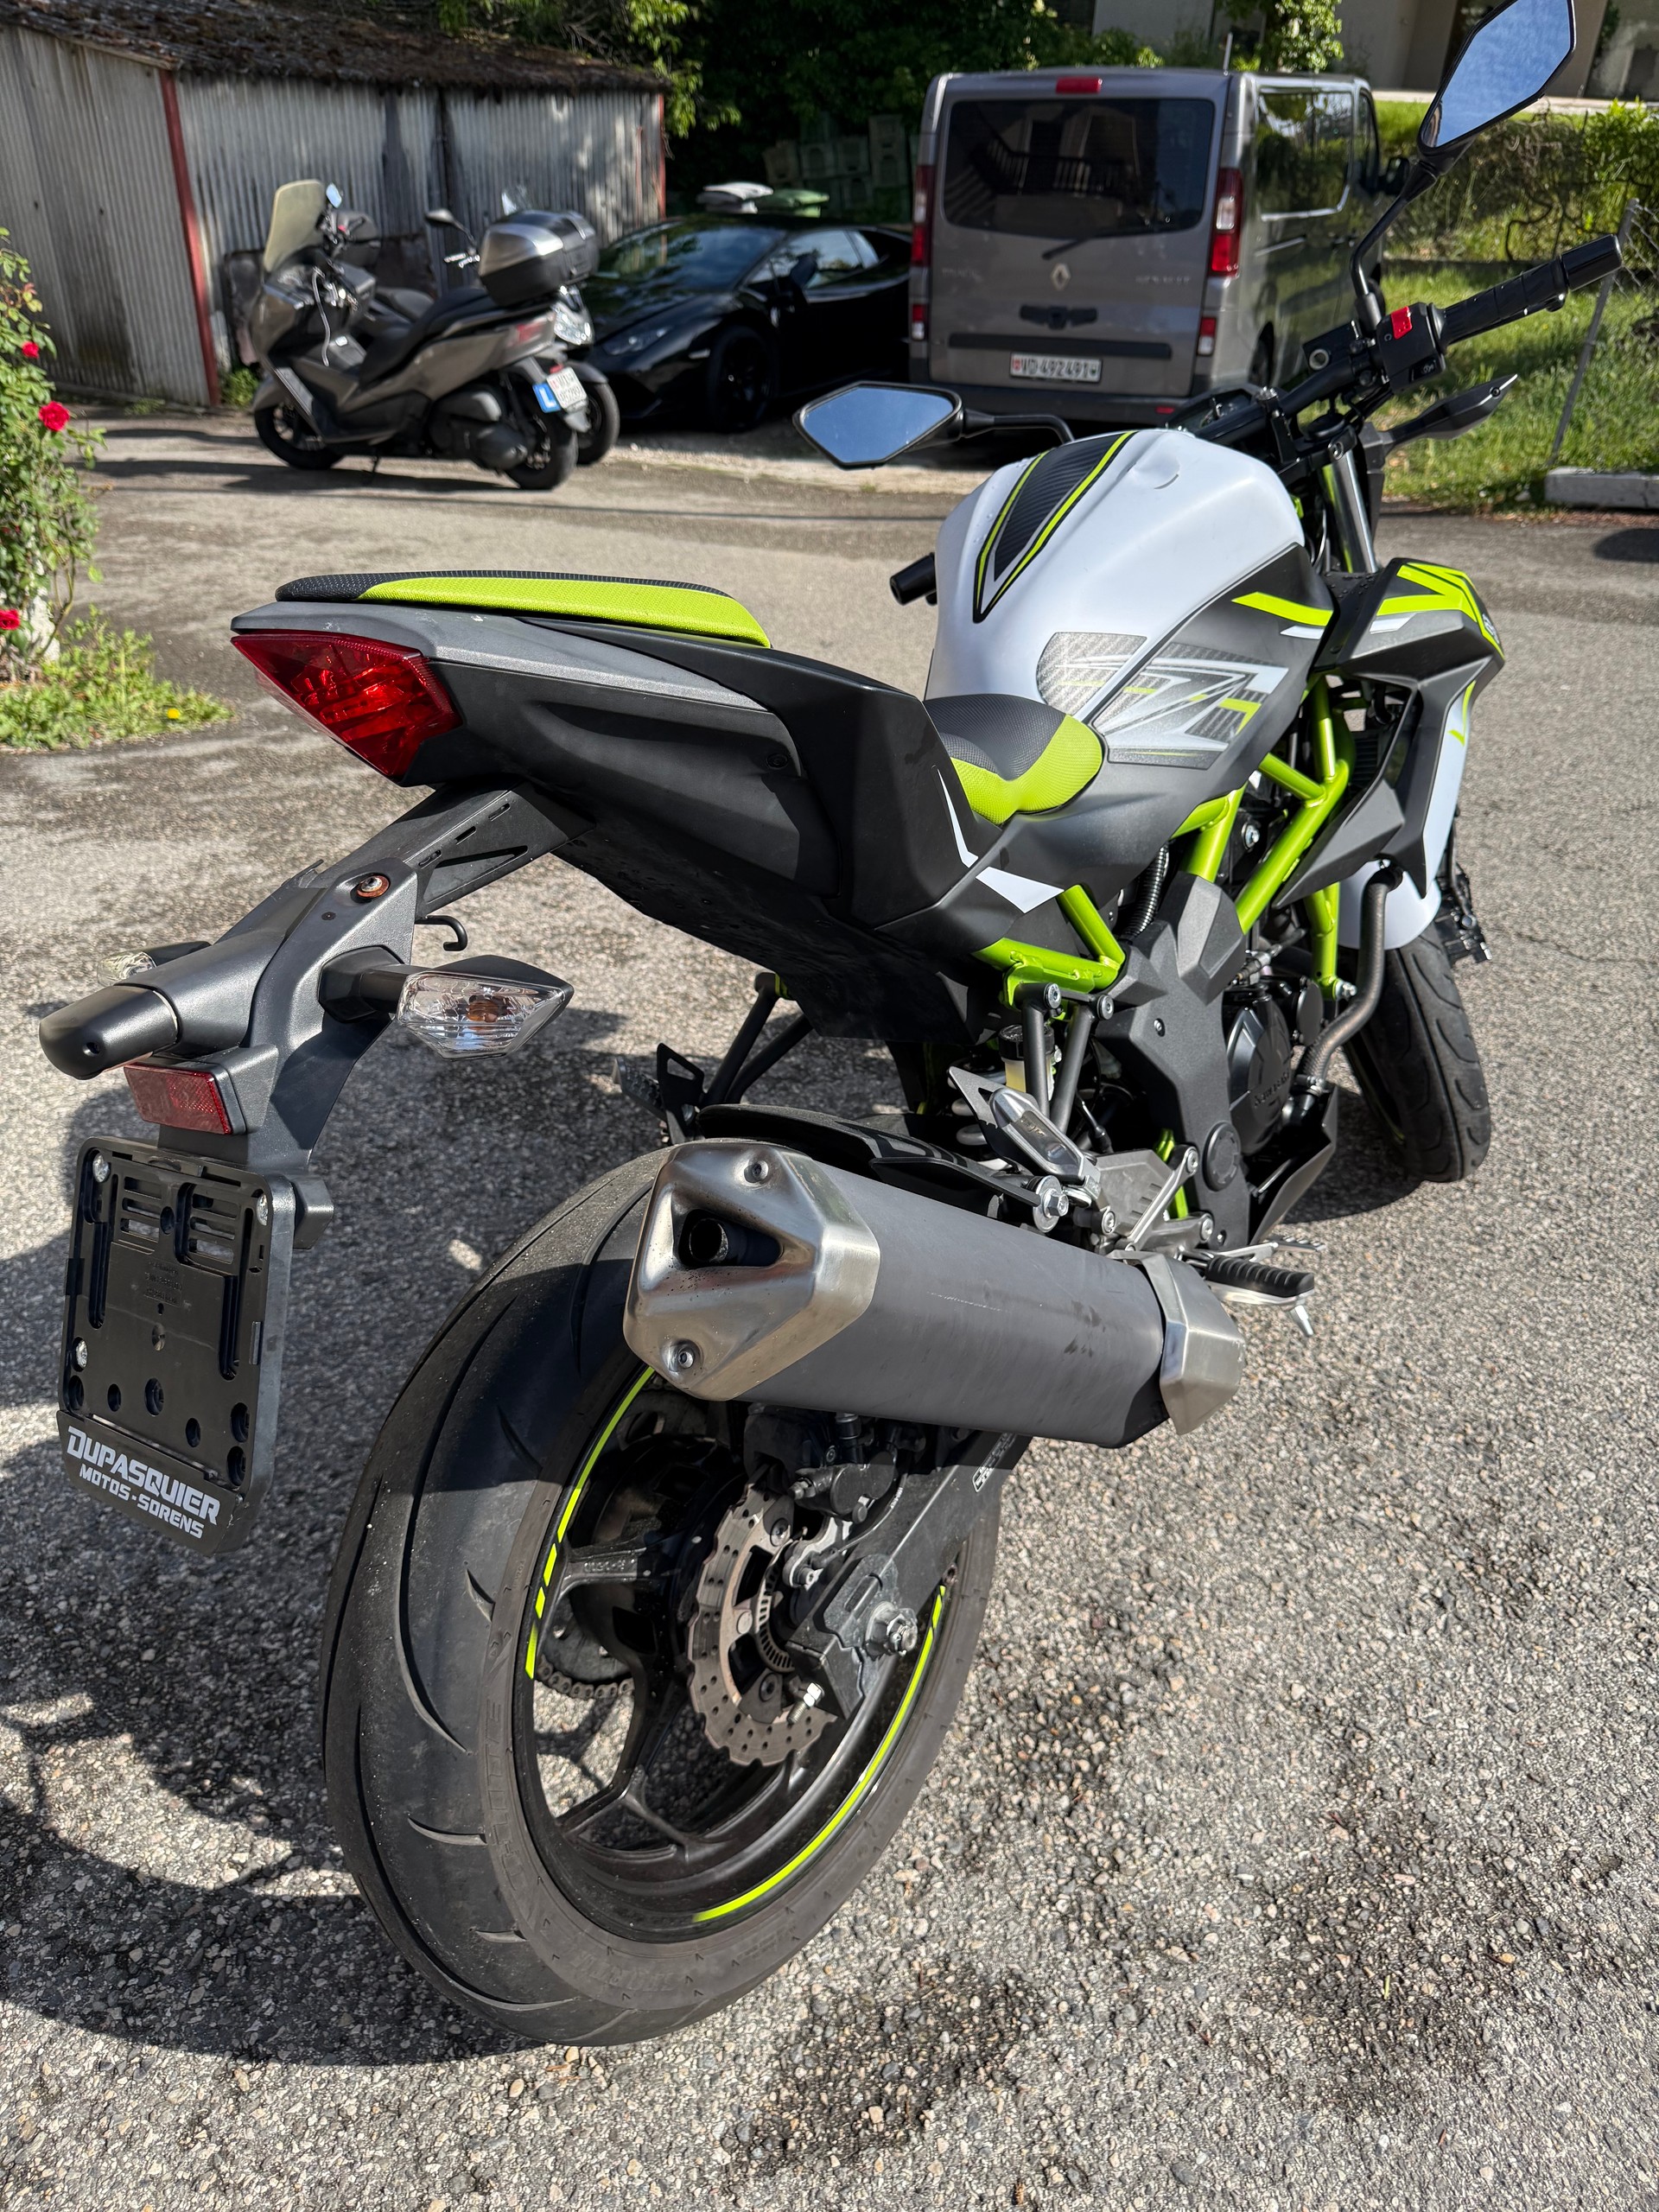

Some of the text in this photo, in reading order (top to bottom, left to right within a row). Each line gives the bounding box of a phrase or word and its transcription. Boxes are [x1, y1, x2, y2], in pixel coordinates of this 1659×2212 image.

[538, 386, 557, 409] L
[67, 1425, 221, 1526] DUPASQUIER
[79, 1463, 206, 1540] MOTOS SORENS
